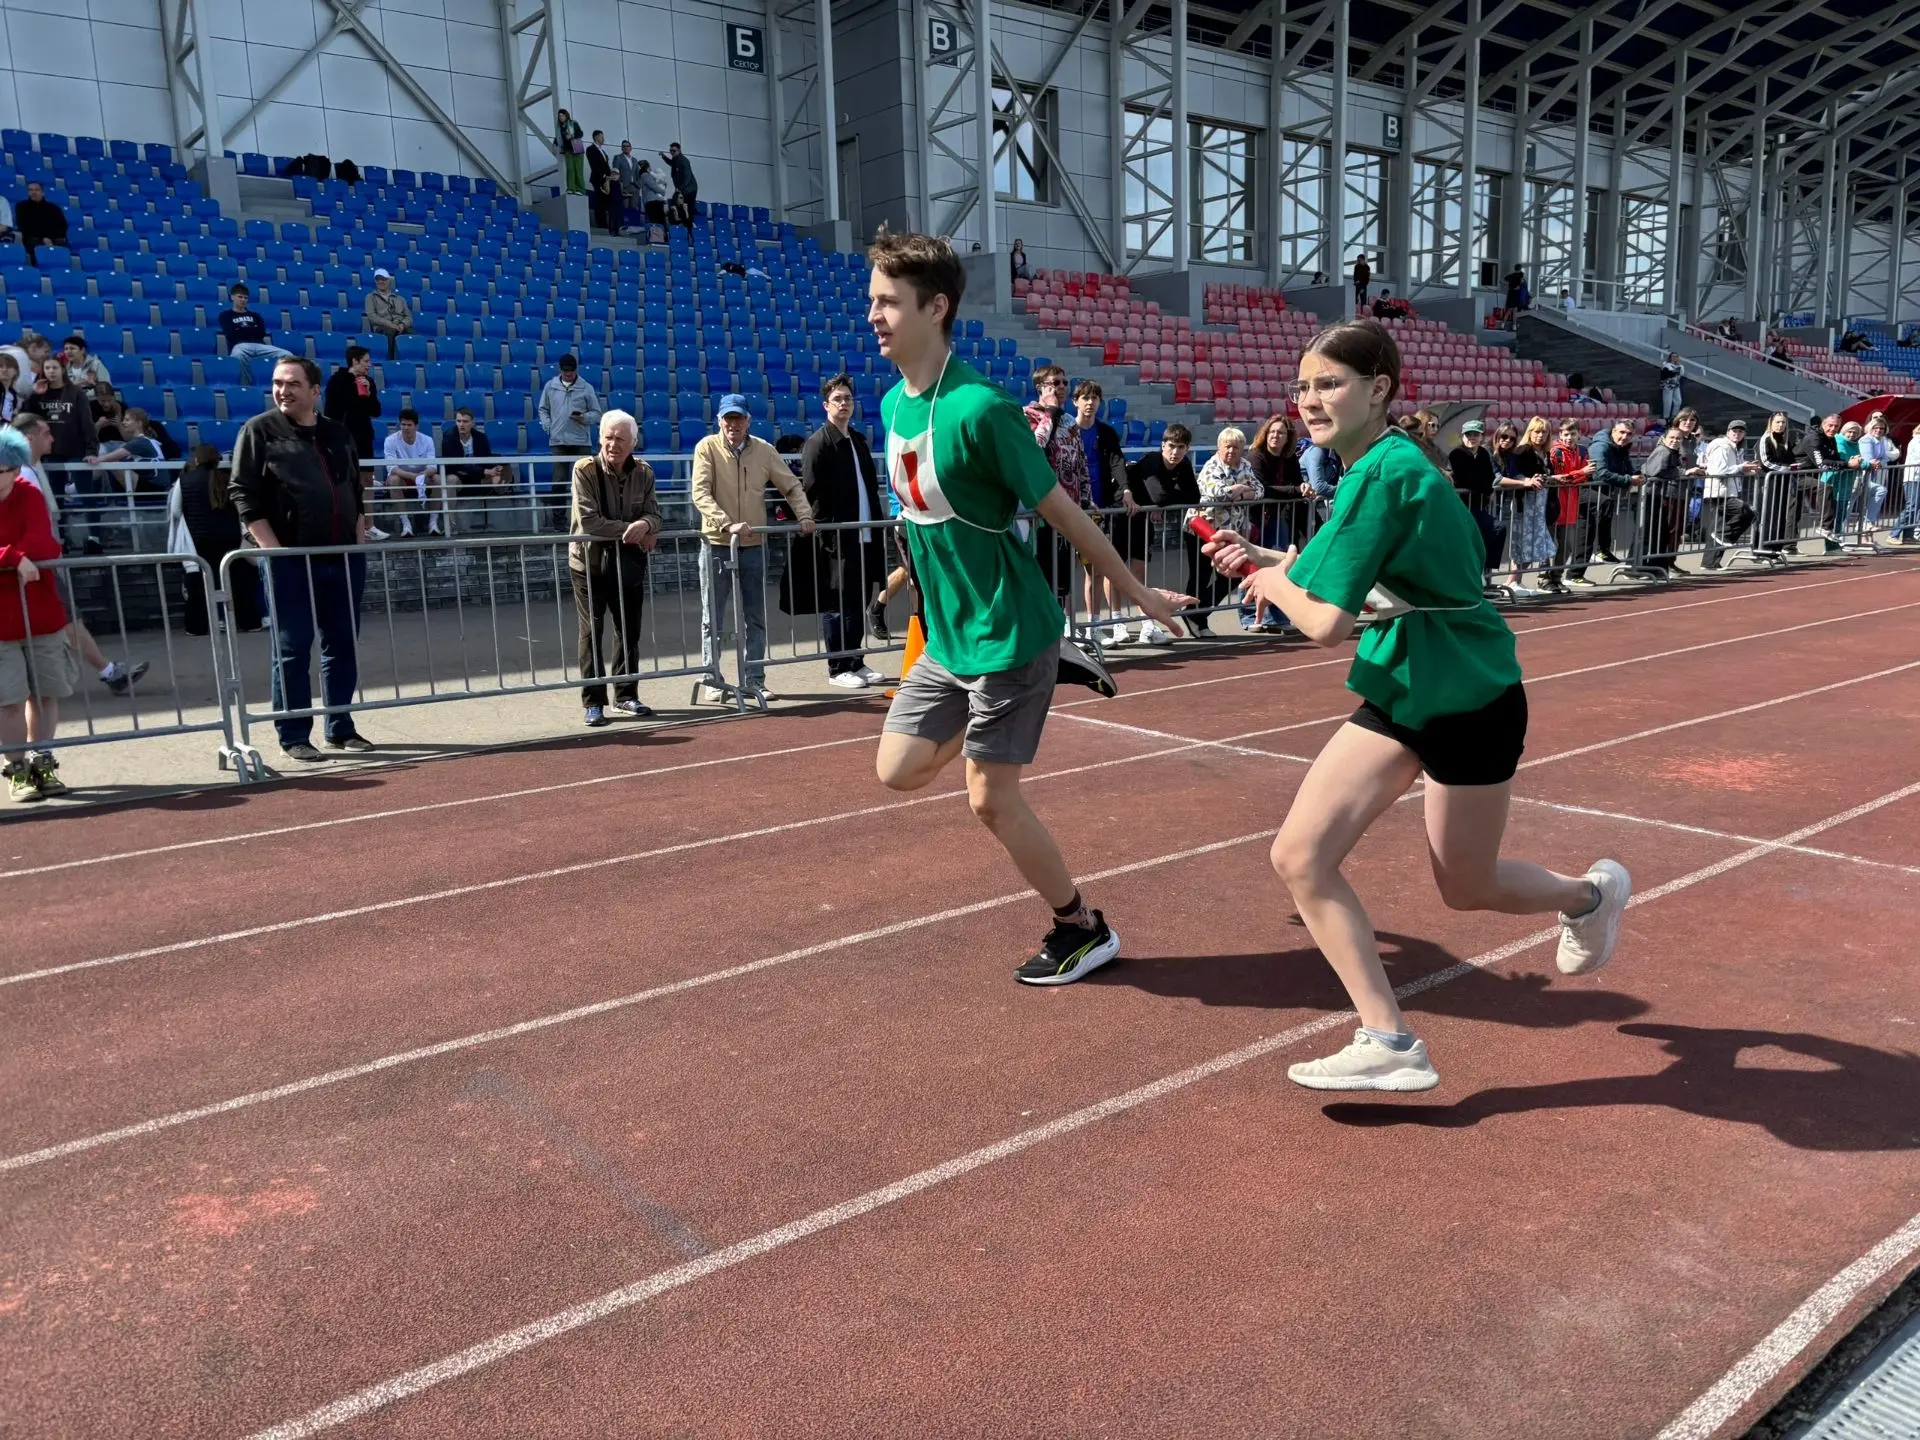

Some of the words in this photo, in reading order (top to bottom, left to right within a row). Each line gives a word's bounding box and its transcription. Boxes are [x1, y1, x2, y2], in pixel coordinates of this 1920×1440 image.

[735, 27, 756, 57] Б
[932, 21, 950, 51] В
[733, 59, 760, 71] СЕКТОР
[1387, 115, 1399, 138] В
